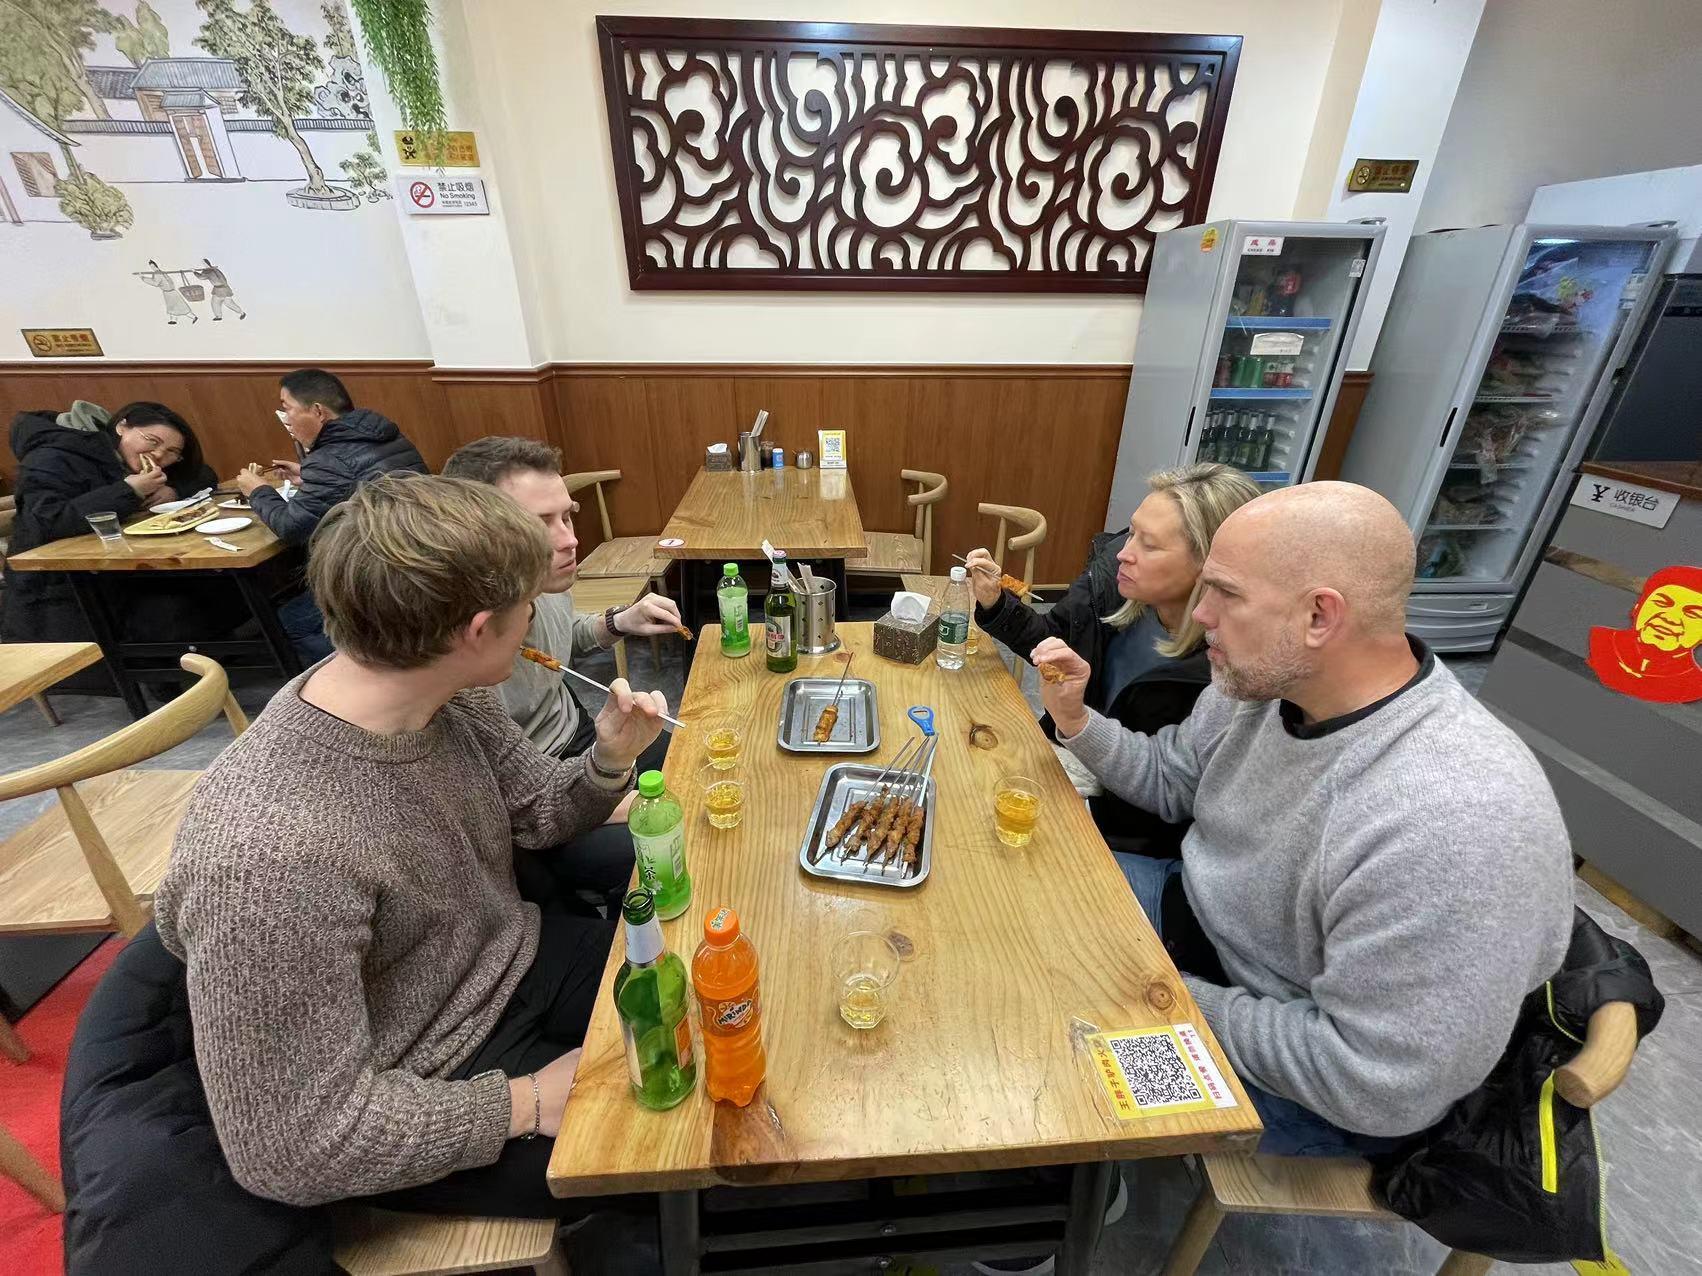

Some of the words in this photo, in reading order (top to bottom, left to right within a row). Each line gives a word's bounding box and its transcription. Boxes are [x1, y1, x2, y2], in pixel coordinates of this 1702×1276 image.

[449, 192, 476, 201] Smoking
[1614, 489, 1659, 511] 收银台
